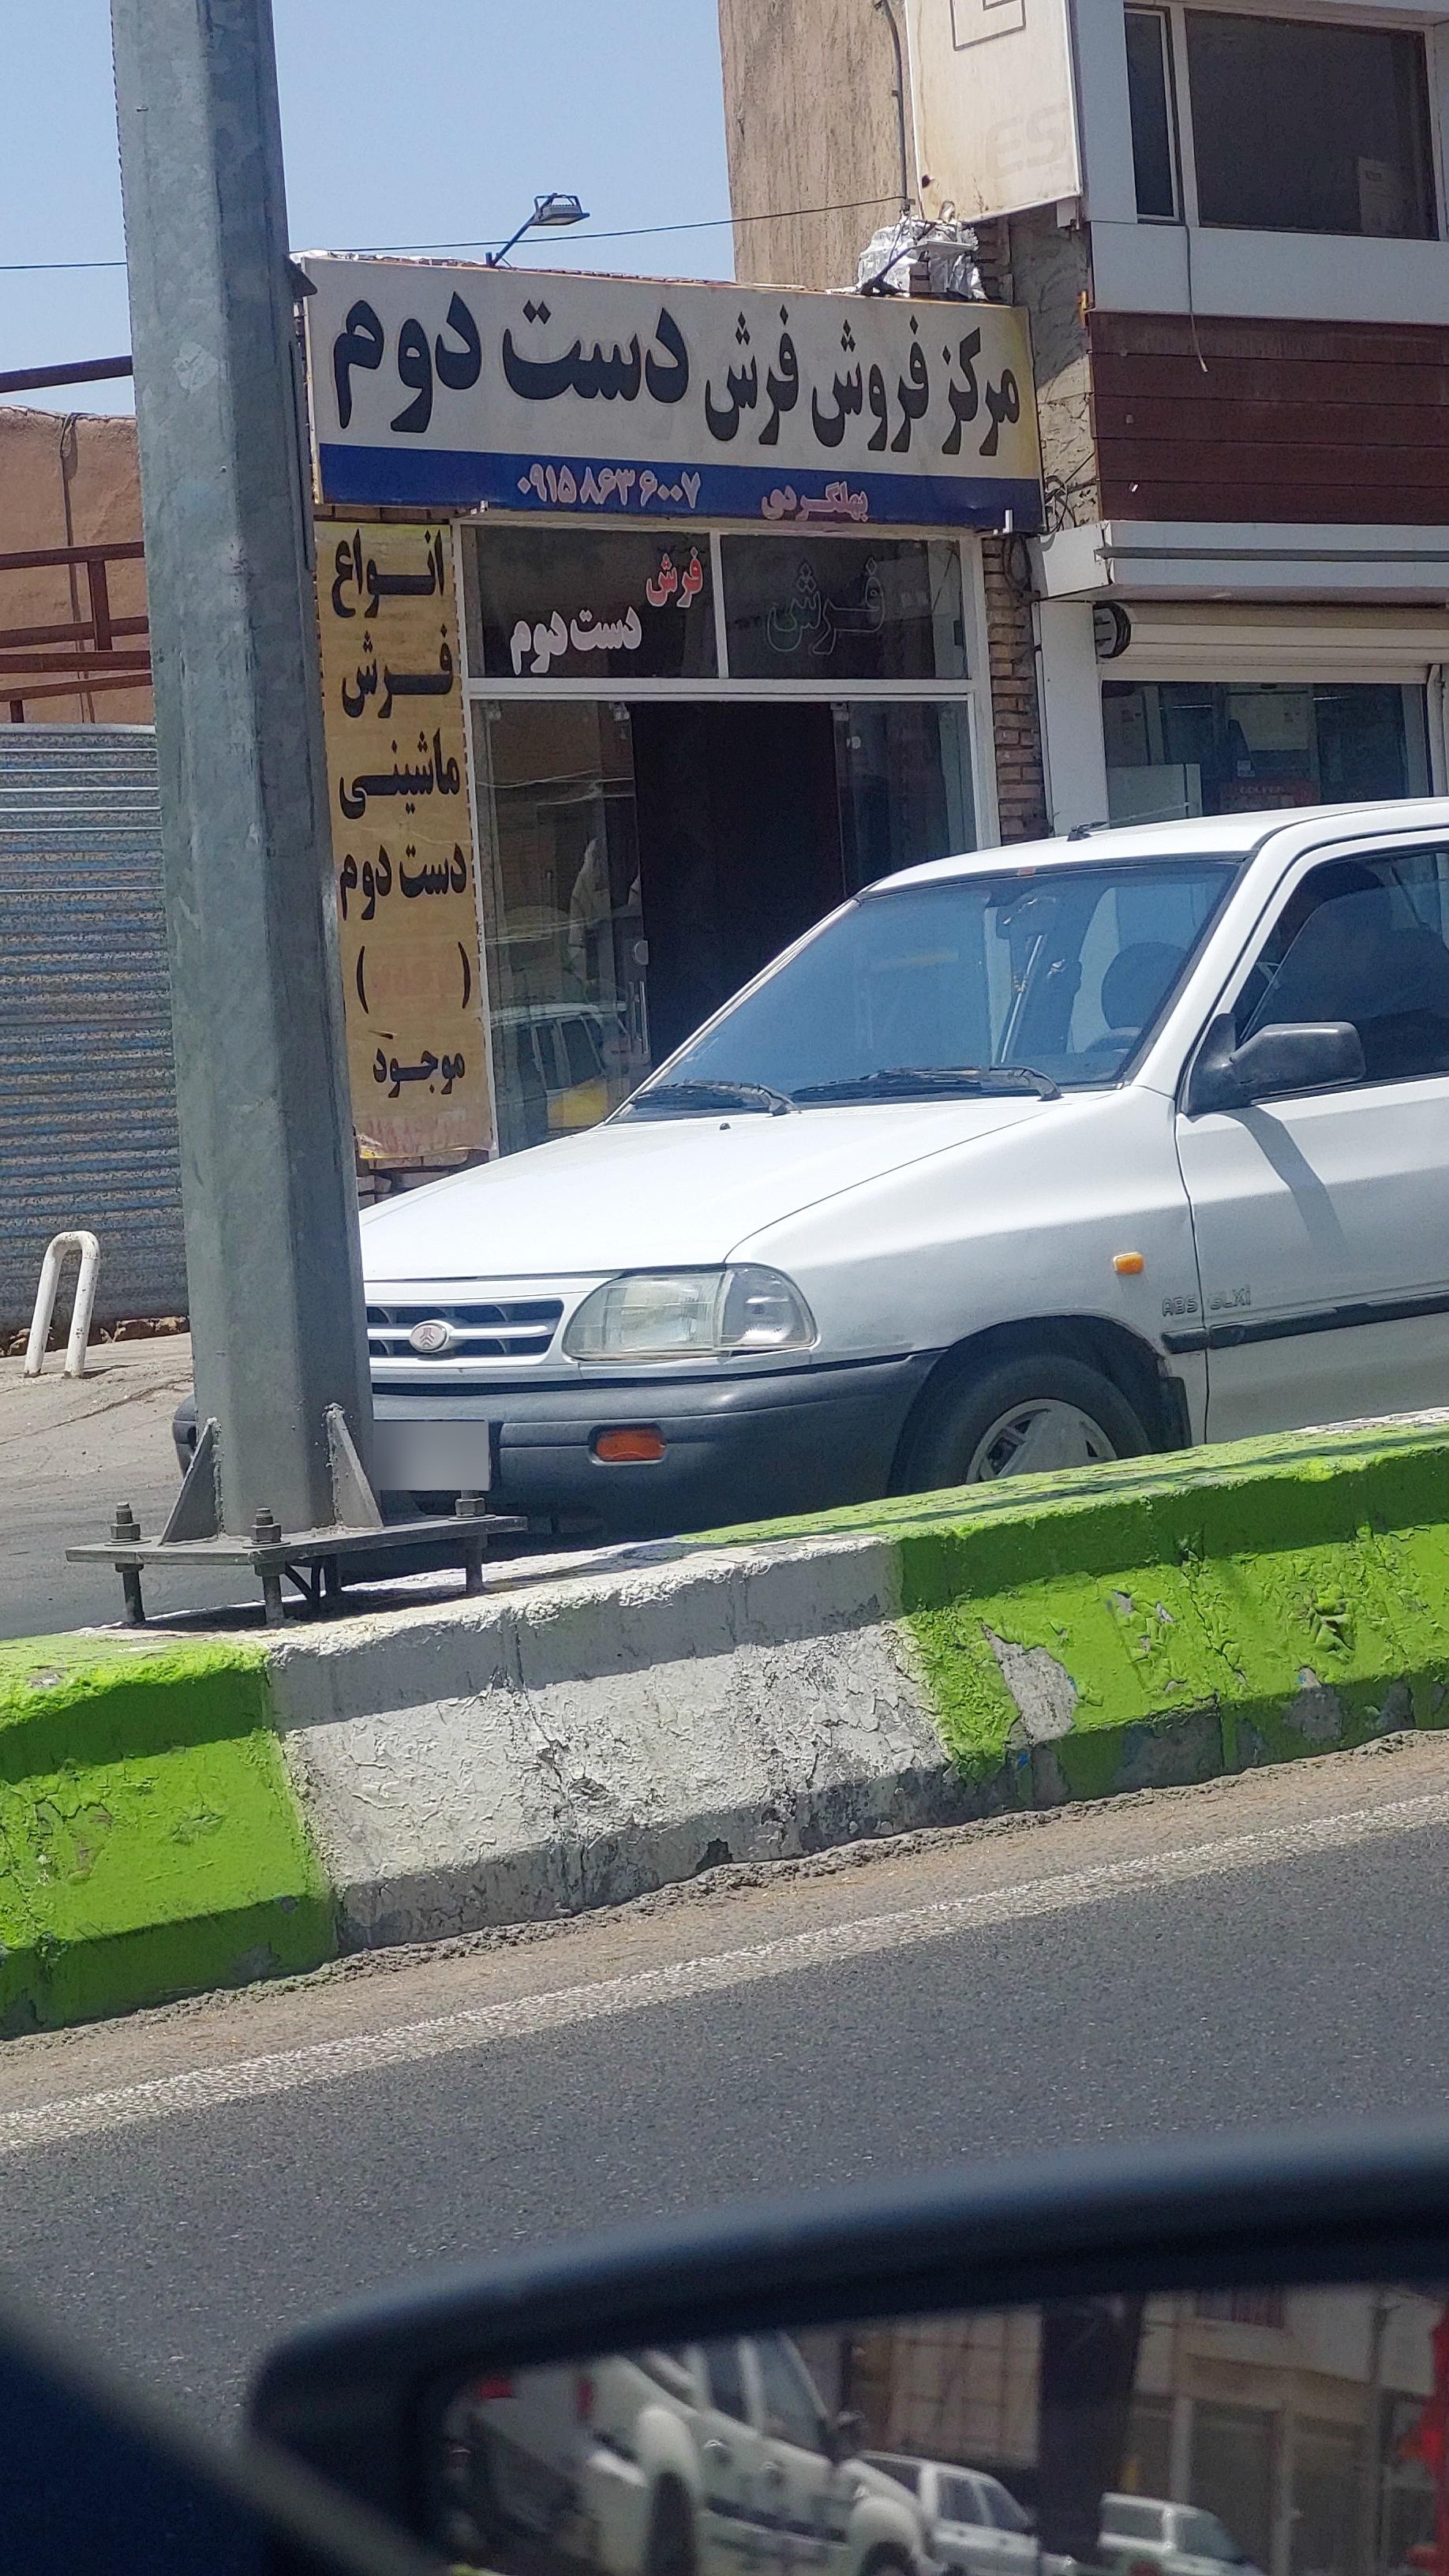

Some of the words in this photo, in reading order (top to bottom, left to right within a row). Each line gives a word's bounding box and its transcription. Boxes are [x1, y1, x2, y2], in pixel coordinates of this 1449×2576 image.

[332, 290, 482, 434] دوم
[502, 299, 690, 404] دست
[704, 304, 799, 446] فرش
[811, 315, 930, 453] فروش
[941, 325, 1021, 457] مرکز
[331, 528, 445, 619] انواع
[646, 546, 703, 608] فرش
[767, 556, 885, 655] فرش
[341, 623, 454, 719] فرش
[510, 611, 568, 676] دوم
[570, 606, 642, 652] دست
[339, 727, 460, 820] ماشینی
[339, 844, 392, 922] دوم
[399, 841, 467, 899] دست
[373, 1047, 466, 1099] موجود
[1162, 1297, 1198, 1317] ABS
